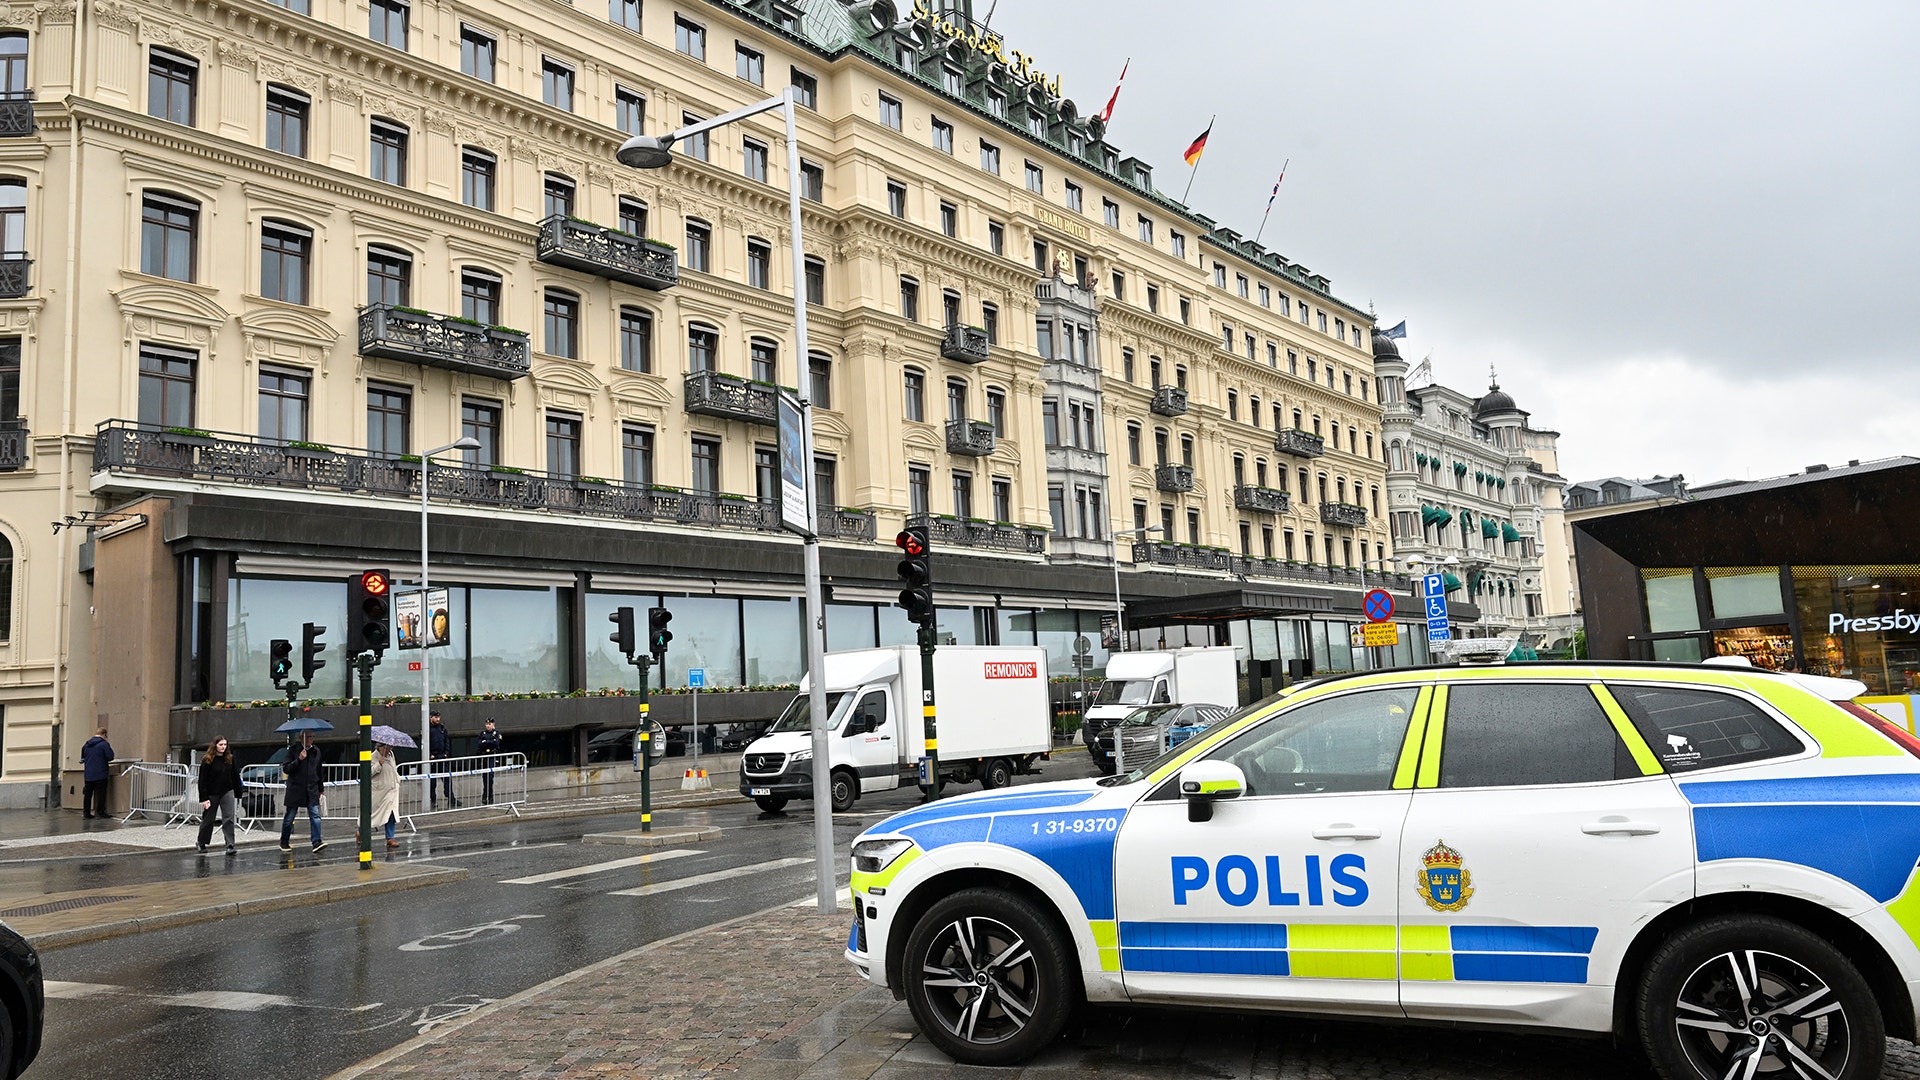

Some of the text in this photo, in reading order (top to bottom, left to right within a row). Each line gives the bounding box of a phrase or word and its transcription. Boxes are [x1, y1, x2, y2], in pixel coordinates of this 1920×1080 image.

[1038, 208, 1063, 229] GRAND
[1428, 576, 1440, 594] P
[1031, 817, 1117, 835] 1 31-9370
[1171, 853, 1370, 907] POLIS
